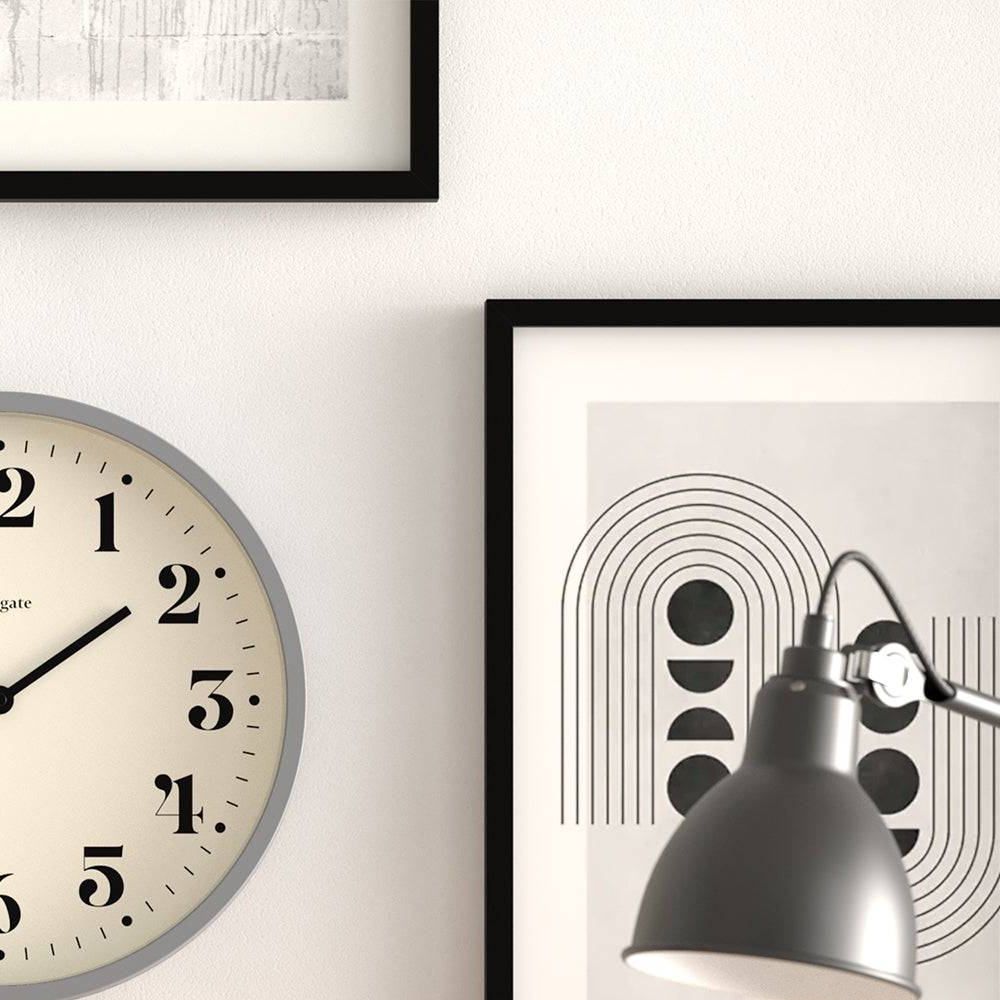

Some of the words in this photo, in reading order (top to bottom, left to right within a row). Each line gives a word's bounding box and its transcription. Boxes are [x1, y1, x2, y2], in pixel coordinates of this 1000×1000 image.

[94, 491, 120, 553] 1
[157, 563, 201, 625] 2
[187, 669, 234, 731] 3
[154, 773, 204, 835] 4
[78, 845, 125, 908] 5
